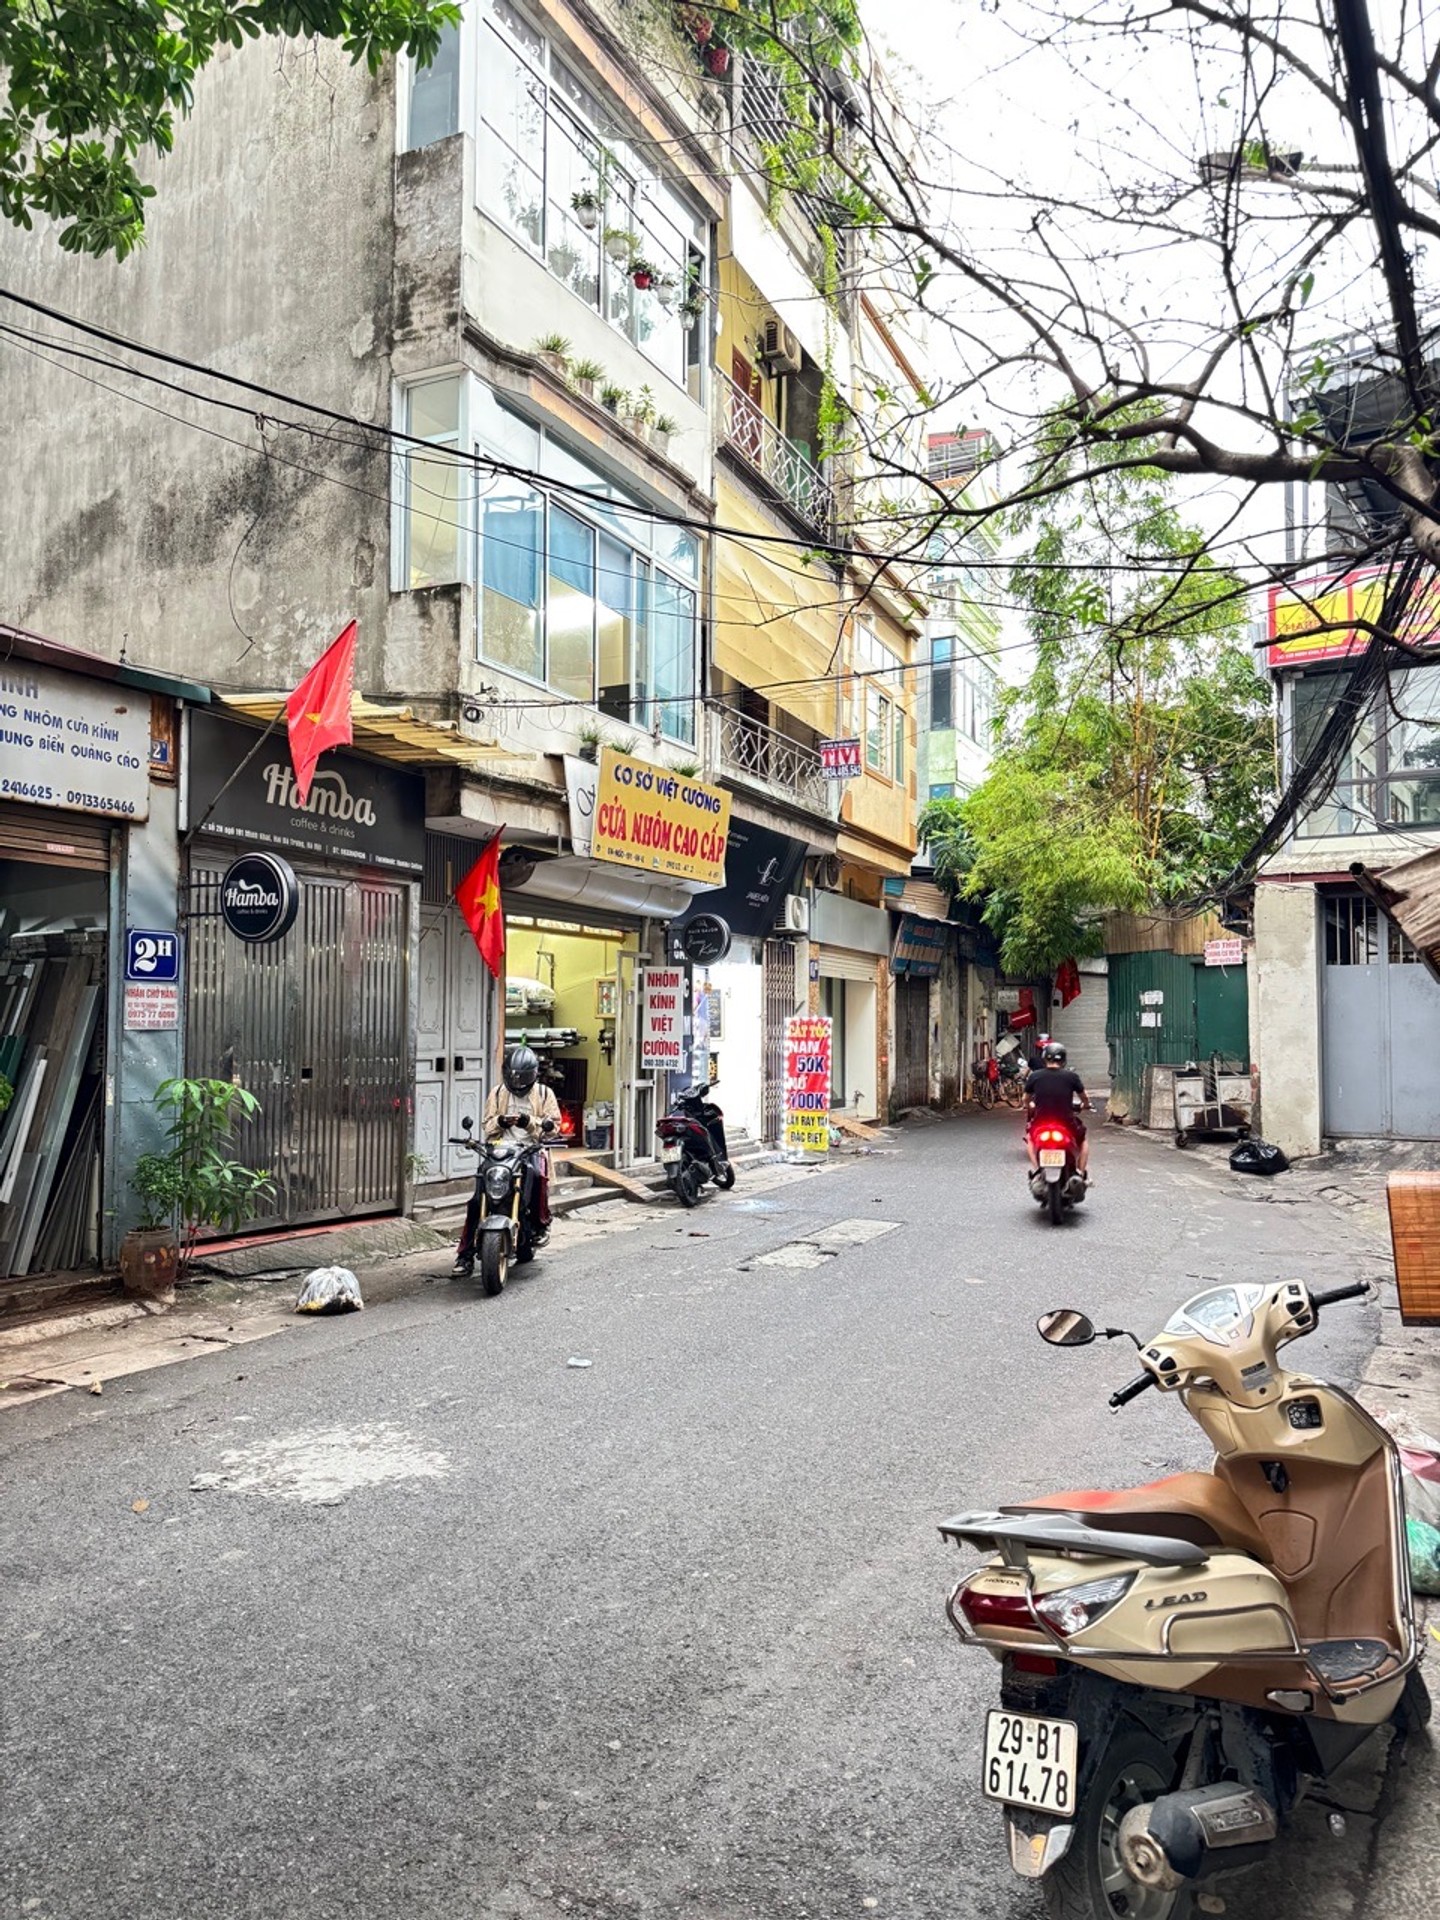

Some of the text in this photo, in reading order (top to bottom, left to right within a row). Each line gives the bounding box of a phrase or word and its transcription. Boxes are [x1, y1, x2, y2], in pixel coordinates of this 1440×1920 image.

[24, 709, 63, 730] NHÔM
[66, 716, 89, 736] CỬA
[92, 721, 119, 742] KÍNH
[70, 743, 113, 763] QUẢNG
[117, 750, 140, 769] CÁO
[821, 746, 861, 767] TIVI
[1, 779, 53, 800] 2416625
[67, 790, 135, 814] 0913365466
[263, 763, 377, 826] Hamba
[614, 764, 722, 814] CƠ SỞ VIỆT CƯỜNG
[290, 816, 356, 839] coffee & drinks
[597, 796, 627, 841] CỬA
[631, 811, 672, 852] NHÔM
[674, 824, 699, 857] CAO
[700, 821, 726, 863] CẤP
[225, 879, 279, 907] Hamba
[133, 938, 173, 972] 2H
[647, 969, 679, 988] NHÔM
[650, 991, 676, 1009] KÍNH
[651, 1014, 674, 1035] VIỆT
[643, 1036, 680, 1056] CƯỜNG
[789, 1040, 820, 1054] NAM
[797, 1056, 825, 1073] 50K
[790, 1093, 824, 1110] 100K
[985, 1577, 1021, 1587] HONDA
[1145, 1591, 1208, 1612] LEAD
[998, 1717, 1062, 1764] 29-B1
[989, 1756, 1068, 1808] 614.78
